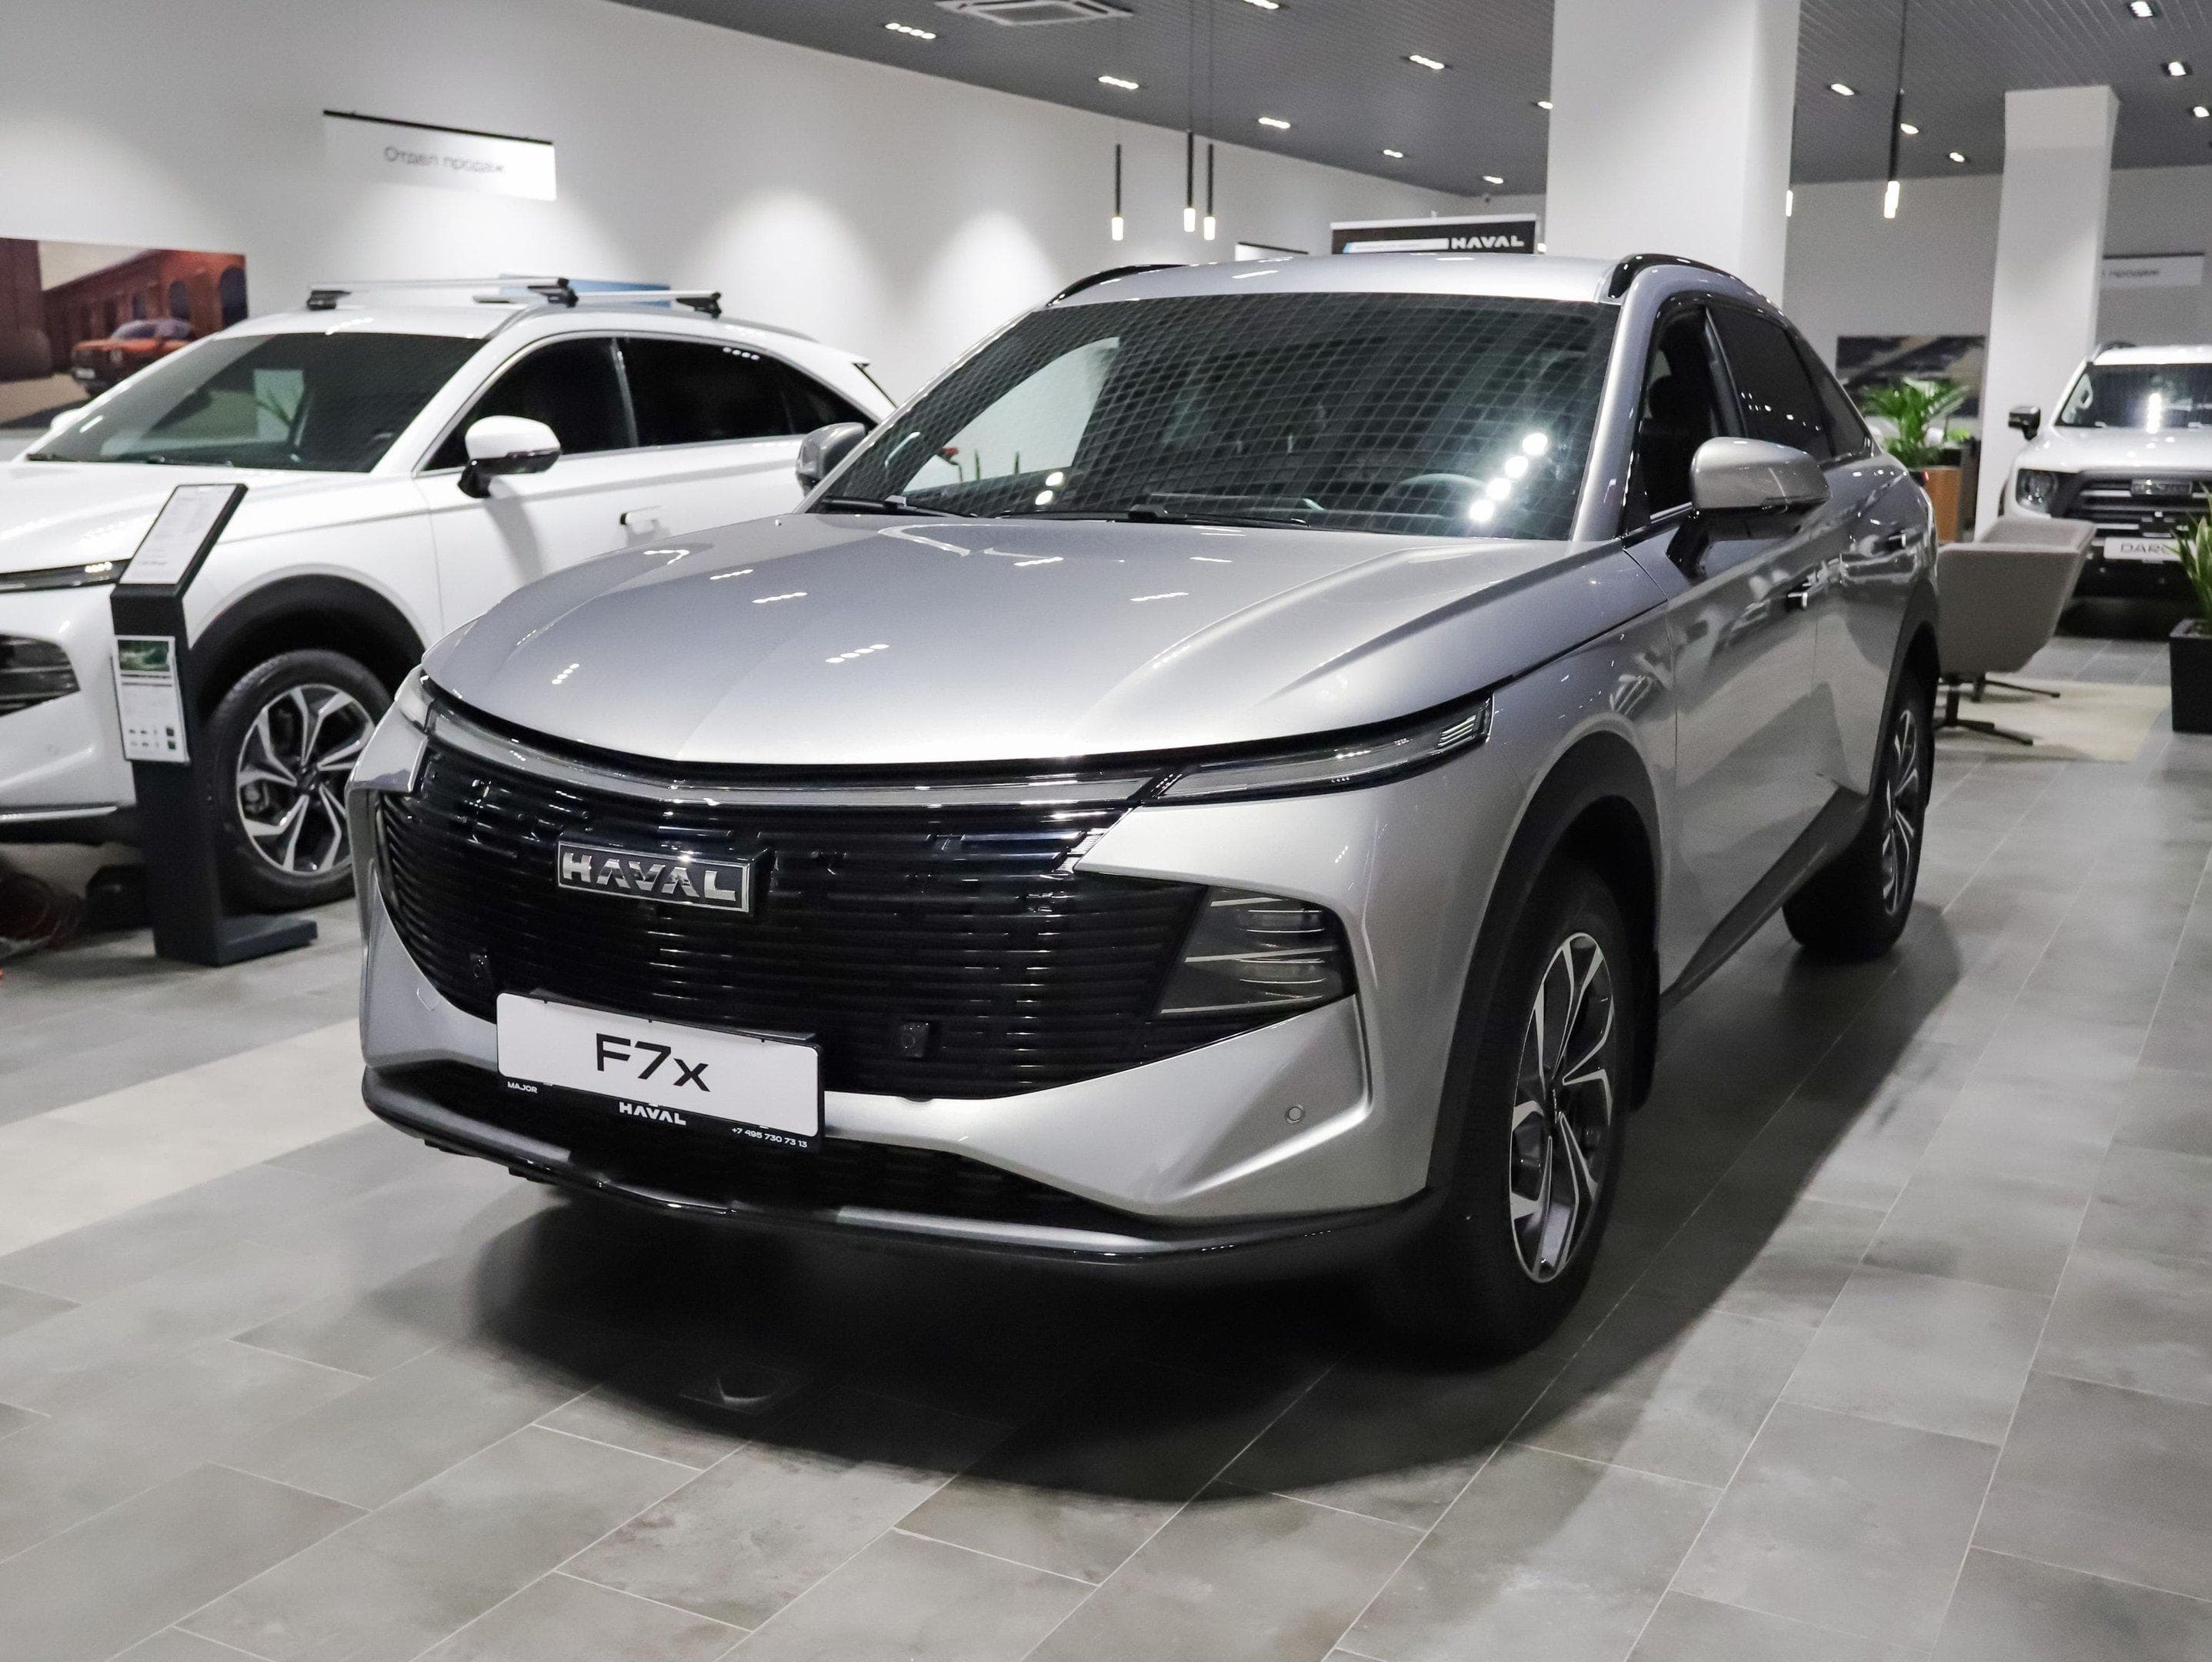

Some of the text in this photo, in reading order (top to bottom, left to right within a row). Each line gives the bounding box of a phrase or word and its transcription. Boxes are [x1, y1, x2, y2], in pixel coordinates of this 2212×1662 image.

[385, 145, 439, 166] Отдел
[1451, 235, 1525, 250] HAVAL
[562, 852, 736, 902] HAVAL
[596, 1033, 711, 1093] F7x
[507, 1081, 538, 1094] MAJOR
[619, 1101, 686, 1126] HAVAL
[744, 1130, 762, 1139] 495
[764, 1133, 782, 1143] 730
[784, 1137, 796, 1146] 73
